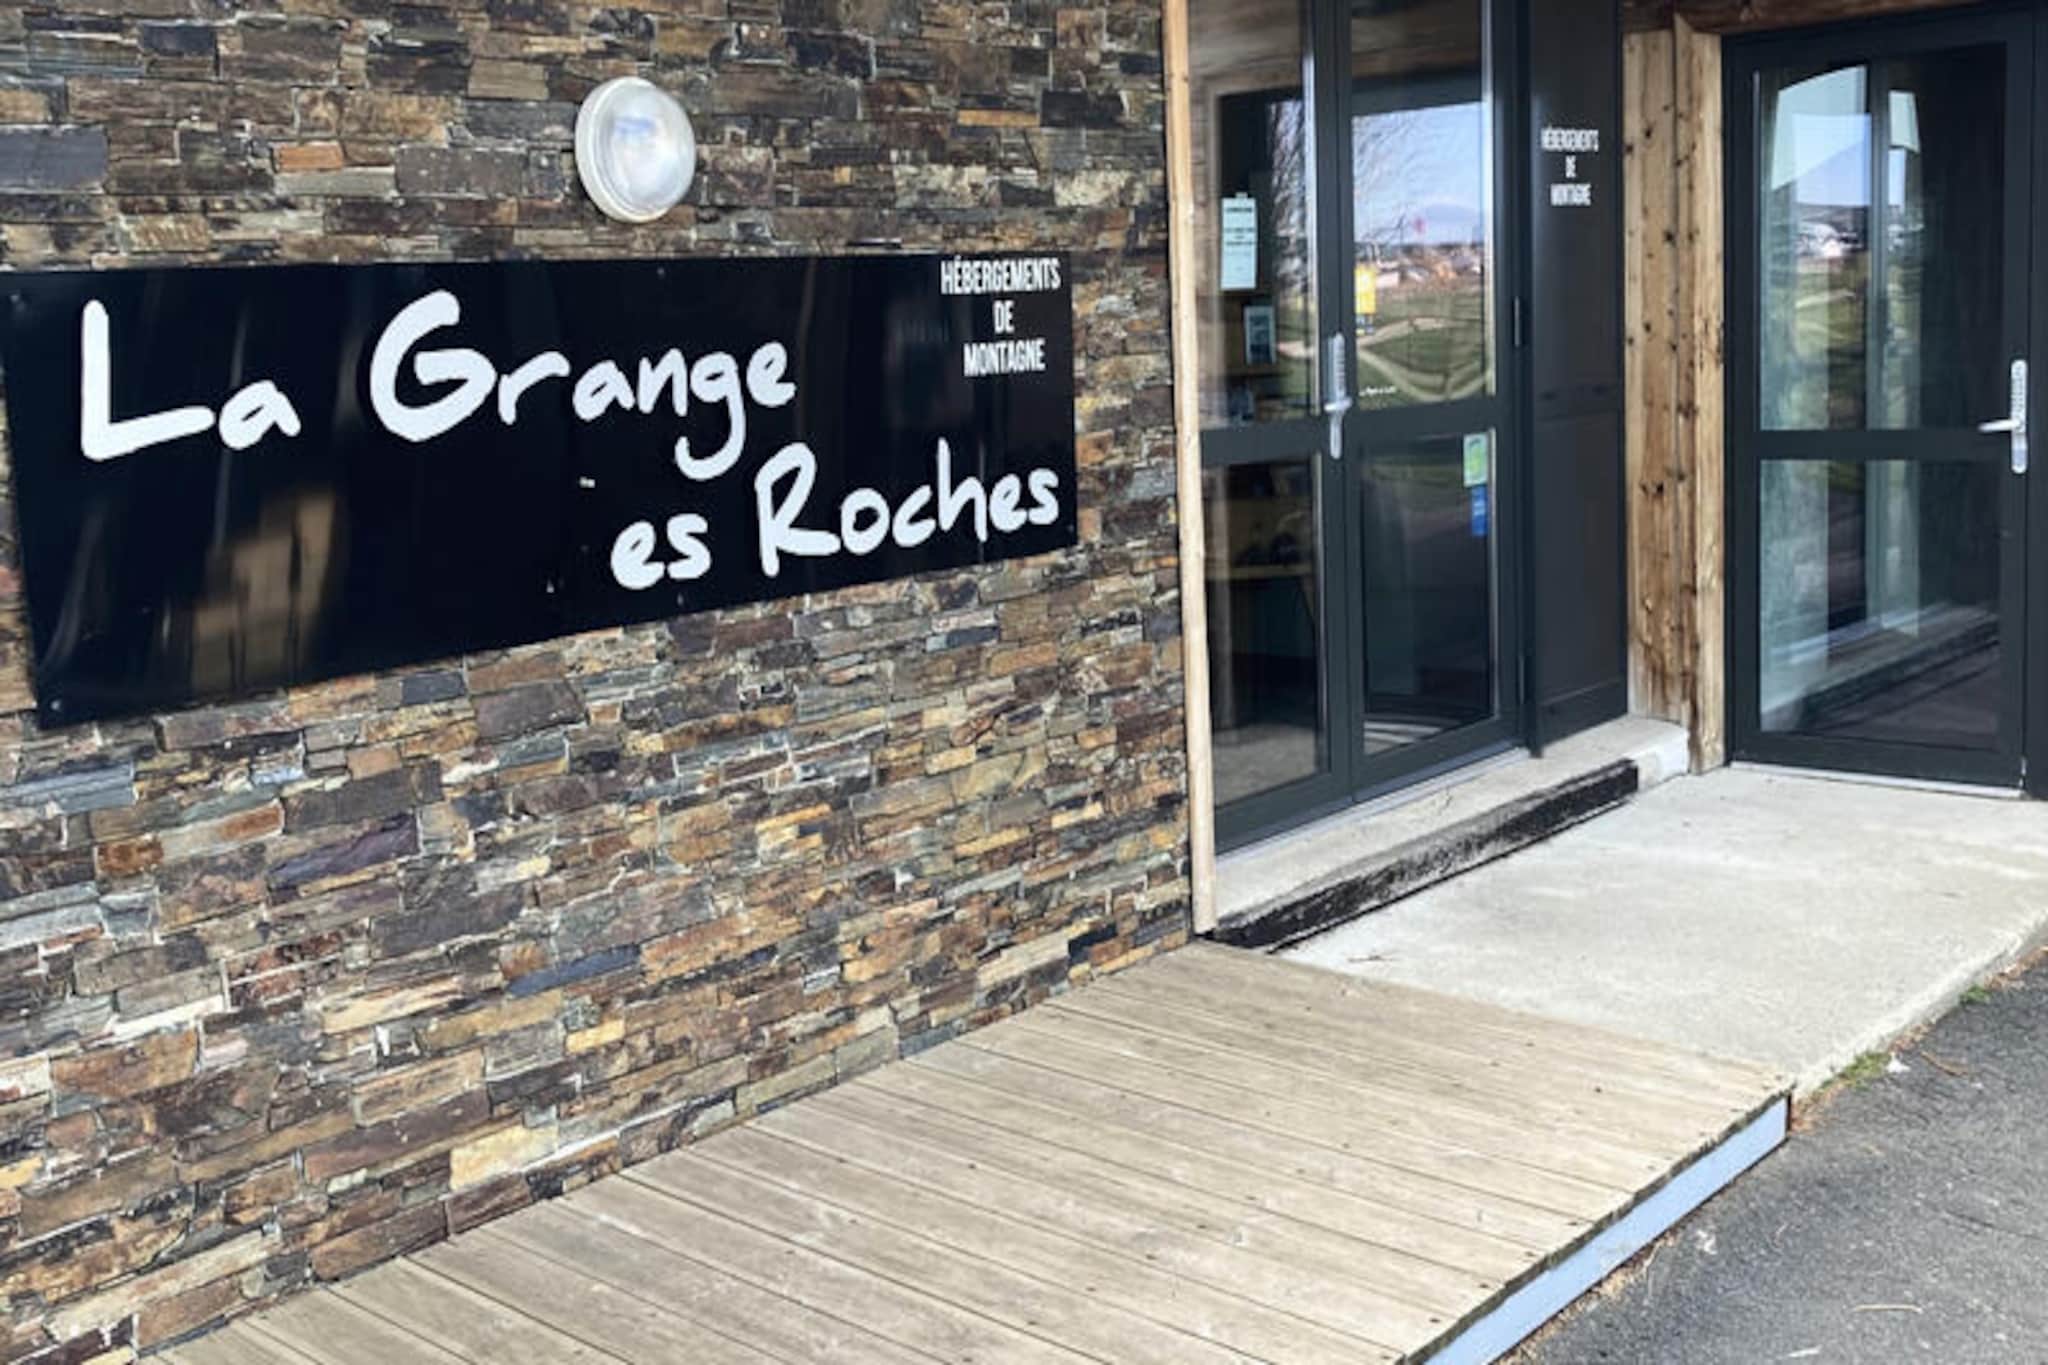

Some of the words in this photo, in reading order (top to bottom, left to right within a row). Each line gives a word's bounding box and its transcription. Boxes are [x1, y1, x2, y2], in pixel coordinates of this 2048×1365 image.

[940, 254, 1062, 295] HÉBERGEMENTS
[992, 299, 1015, 334] DE
[963, 337, 1046, 377] MONTAGNE
[80, 299, 302, 463] La
[369, 289, 797, 482] Grange
[610, 513, 713, 590] es
[754, 437, 1060, 577] Roches
